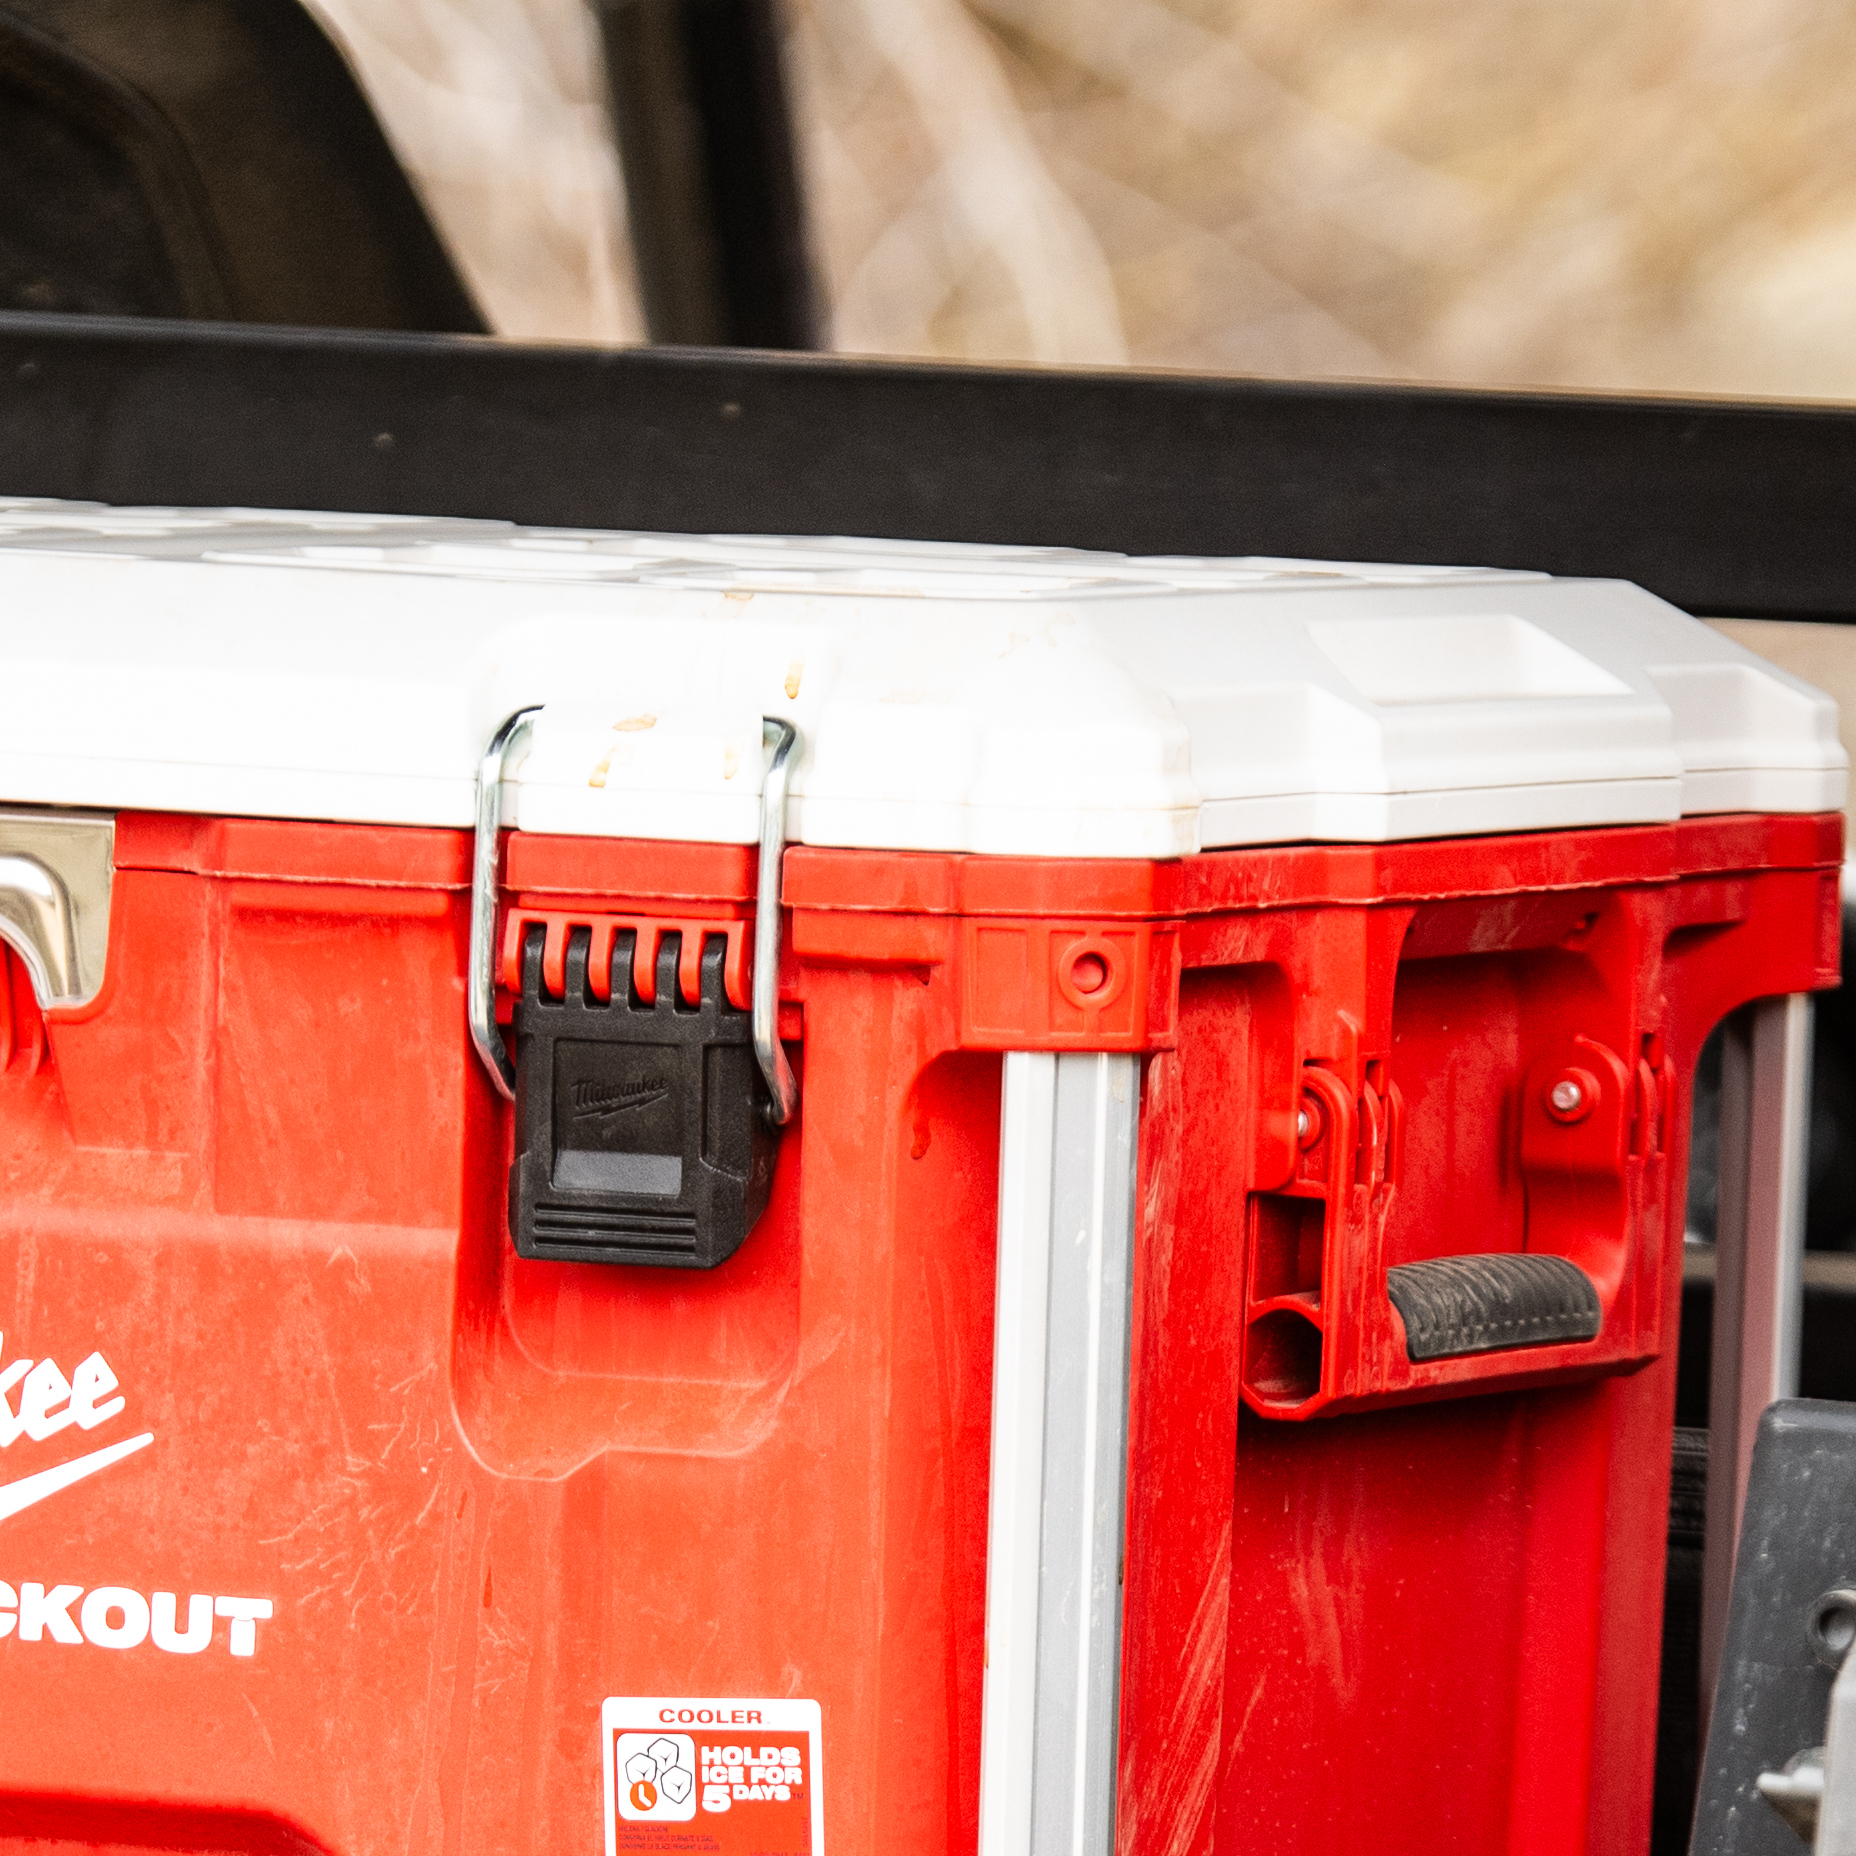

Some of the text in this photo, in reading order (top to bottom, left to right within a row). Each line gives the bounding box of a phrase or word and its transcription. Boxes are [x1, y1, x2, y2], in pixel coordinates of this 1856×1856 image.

[658, 1708, 762, 1724] COOLER
[701, 1745, 802, 1767] HOLDS
[701, 1766, 803, 1785] ICE FOR
[701, 1784, 732, 1813] 5
[732, 1784, 791, 1802] DAYS
